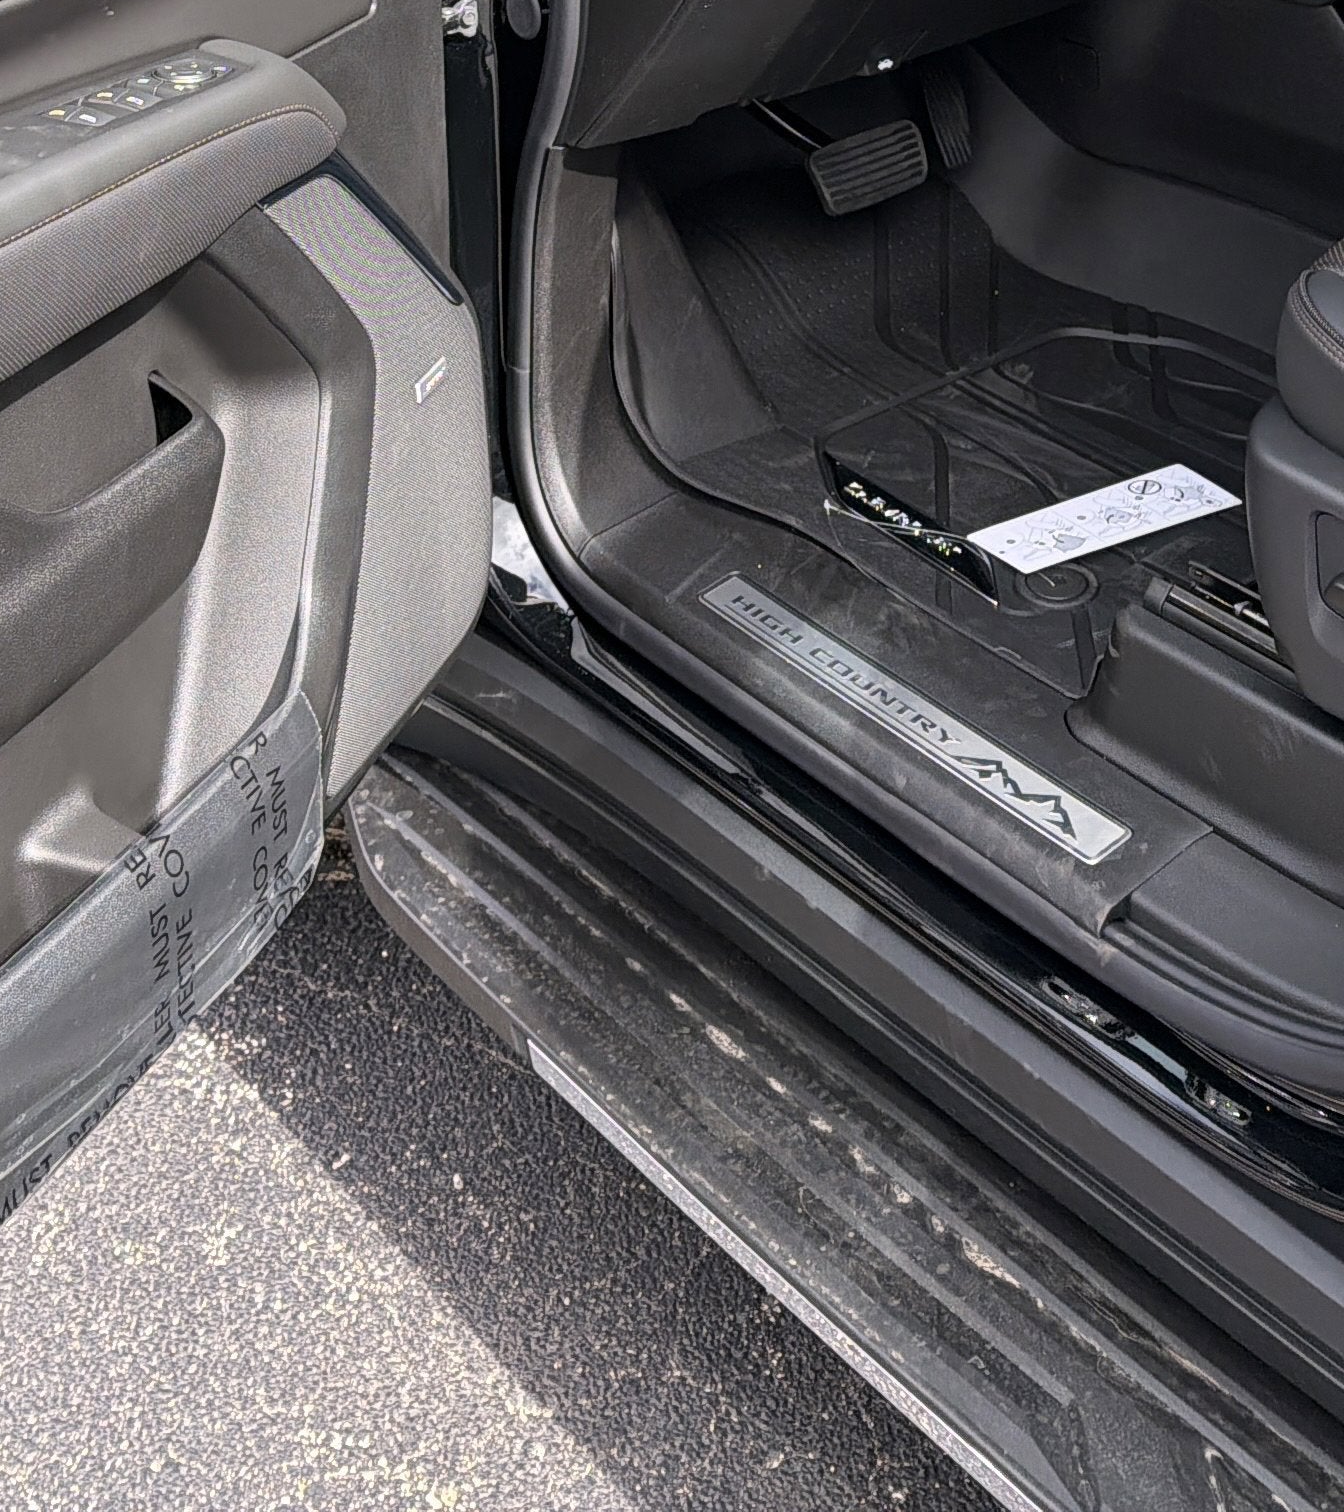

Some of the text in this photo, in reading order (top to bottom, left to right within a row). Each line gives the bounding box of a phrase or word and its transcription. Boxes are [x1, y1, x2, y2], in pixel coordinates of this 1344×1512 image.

[729, 594, 963, 746] HIGH COUNTRY
[266, 763, 288, 842] MUST
[148, 902, 171, 984] MUST
